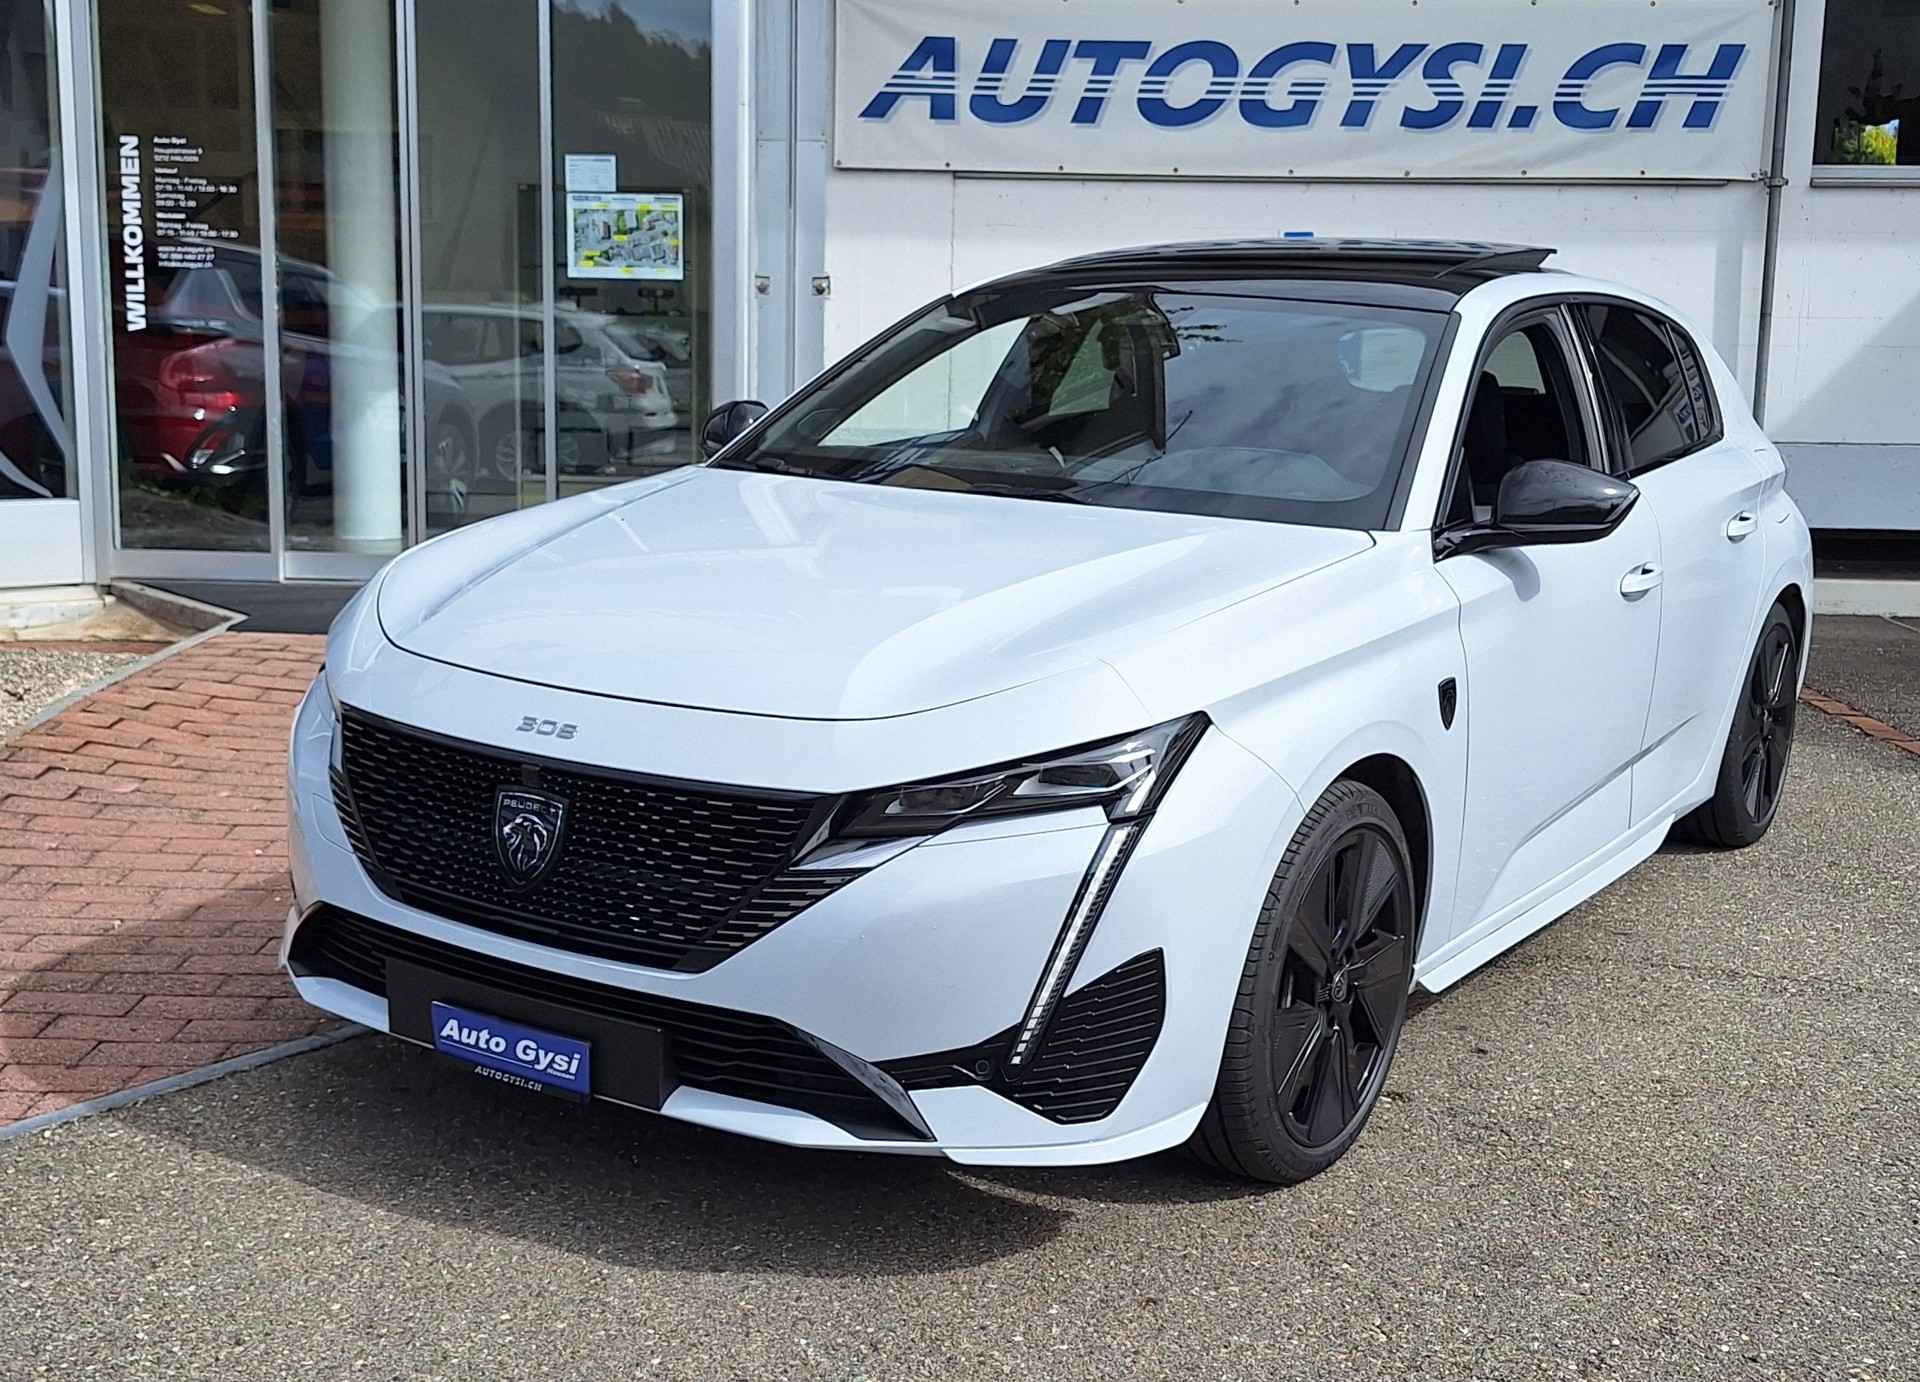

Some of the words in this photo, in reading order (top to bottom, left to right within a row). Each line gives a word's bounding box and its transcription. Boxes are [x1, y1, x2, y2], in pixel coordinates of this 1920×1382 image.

[859, 36, 1748, 131] AUTOGYSI.CH
[119, 135, 147, 332] WILLKOMMEN
[516, 715, 579, 740] 308
[440, 1018, 507, 1053] Auto
[515, 1039, 581, 1071] Gysi
[474, 1066, 543, 1092] AUTOGYSI.CH
